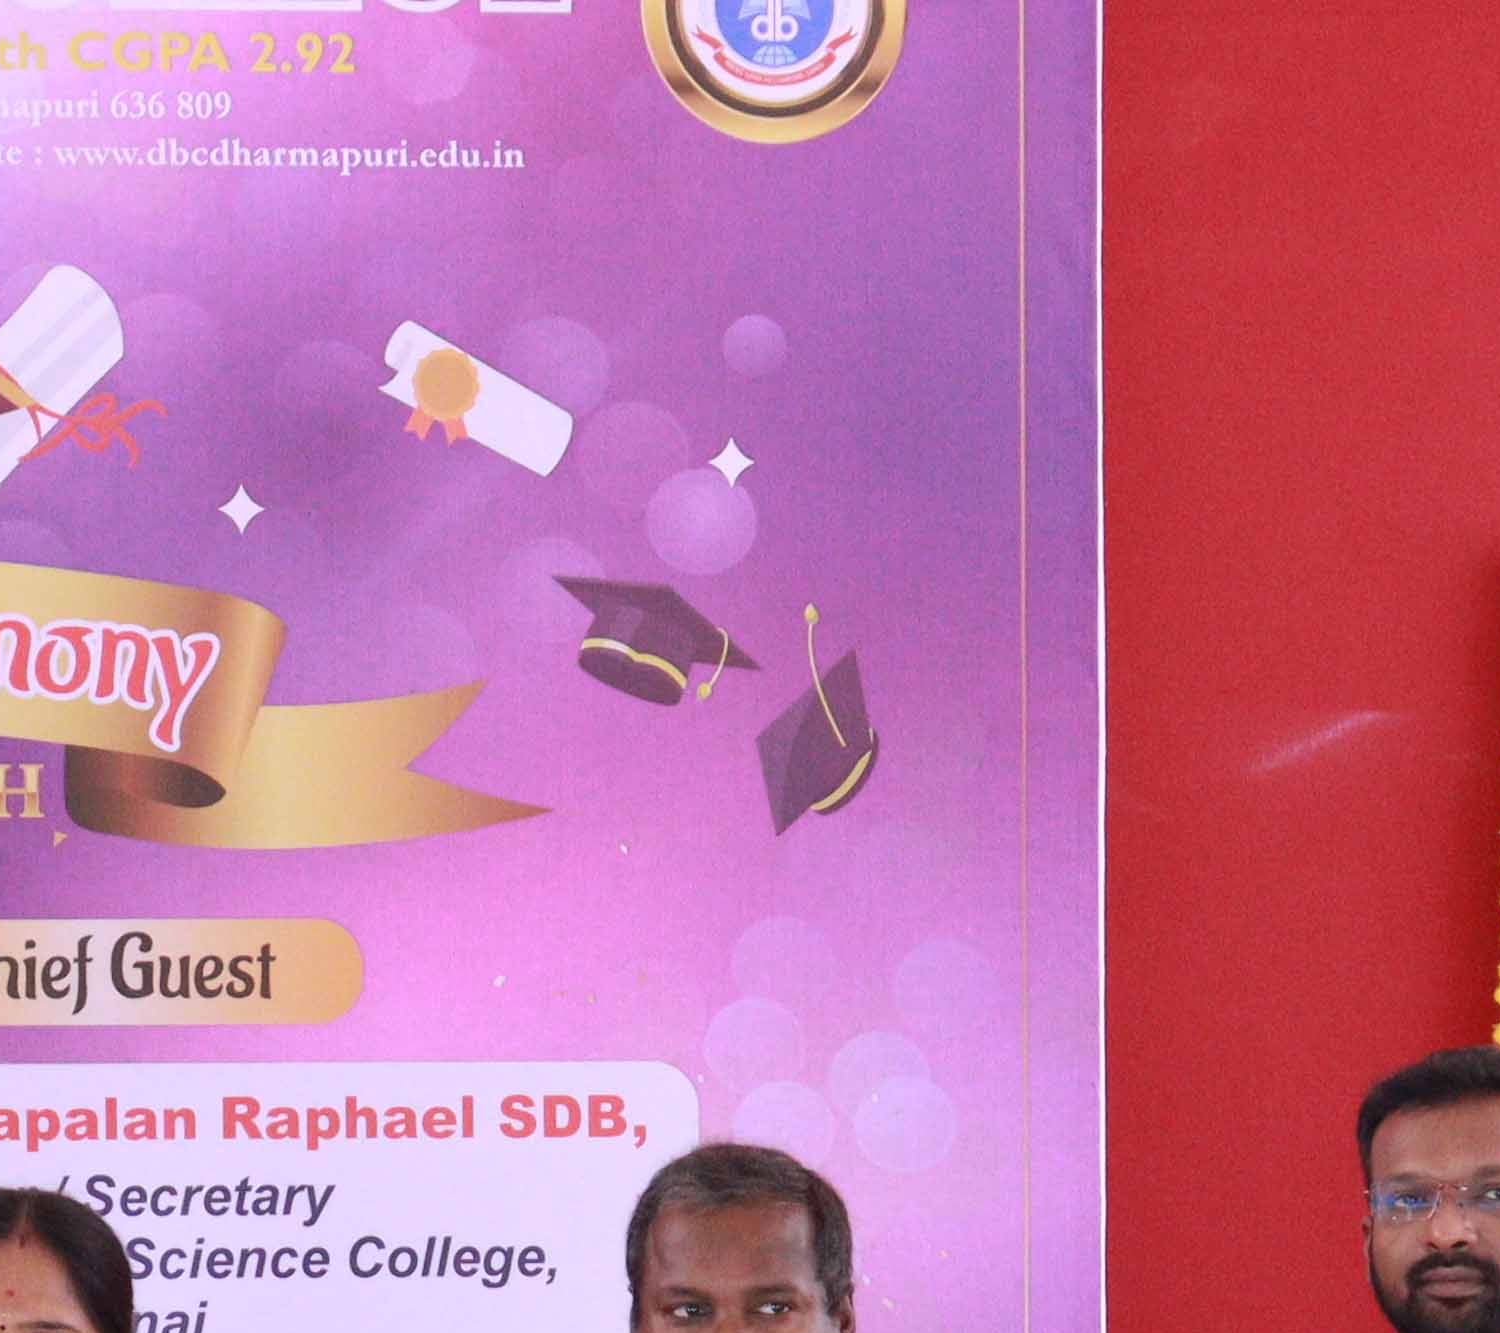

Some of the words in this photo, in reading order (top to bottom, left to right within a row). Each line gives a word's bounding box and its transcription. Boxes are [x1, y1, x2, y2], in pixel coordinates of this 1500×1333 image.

[67, 30, 232, 73] CGPA
[248, 31, 356, 74] 2.92
[110, 89, 166, 120] 636
[176, 89, 233, 120] 809
[55, 136, 525, 176] www.dbcdharmapuri.edu.in
[109, 931, 276, 1000] Guest
[222, 1096, 473, 1150] Raphael
[499, 1094, 648, 1149] SDB,
[85, 1174, 335, 1226] Secretary
[124, 1236, 330, 1280] Science
[348, 1235, 558, 1287] College,
